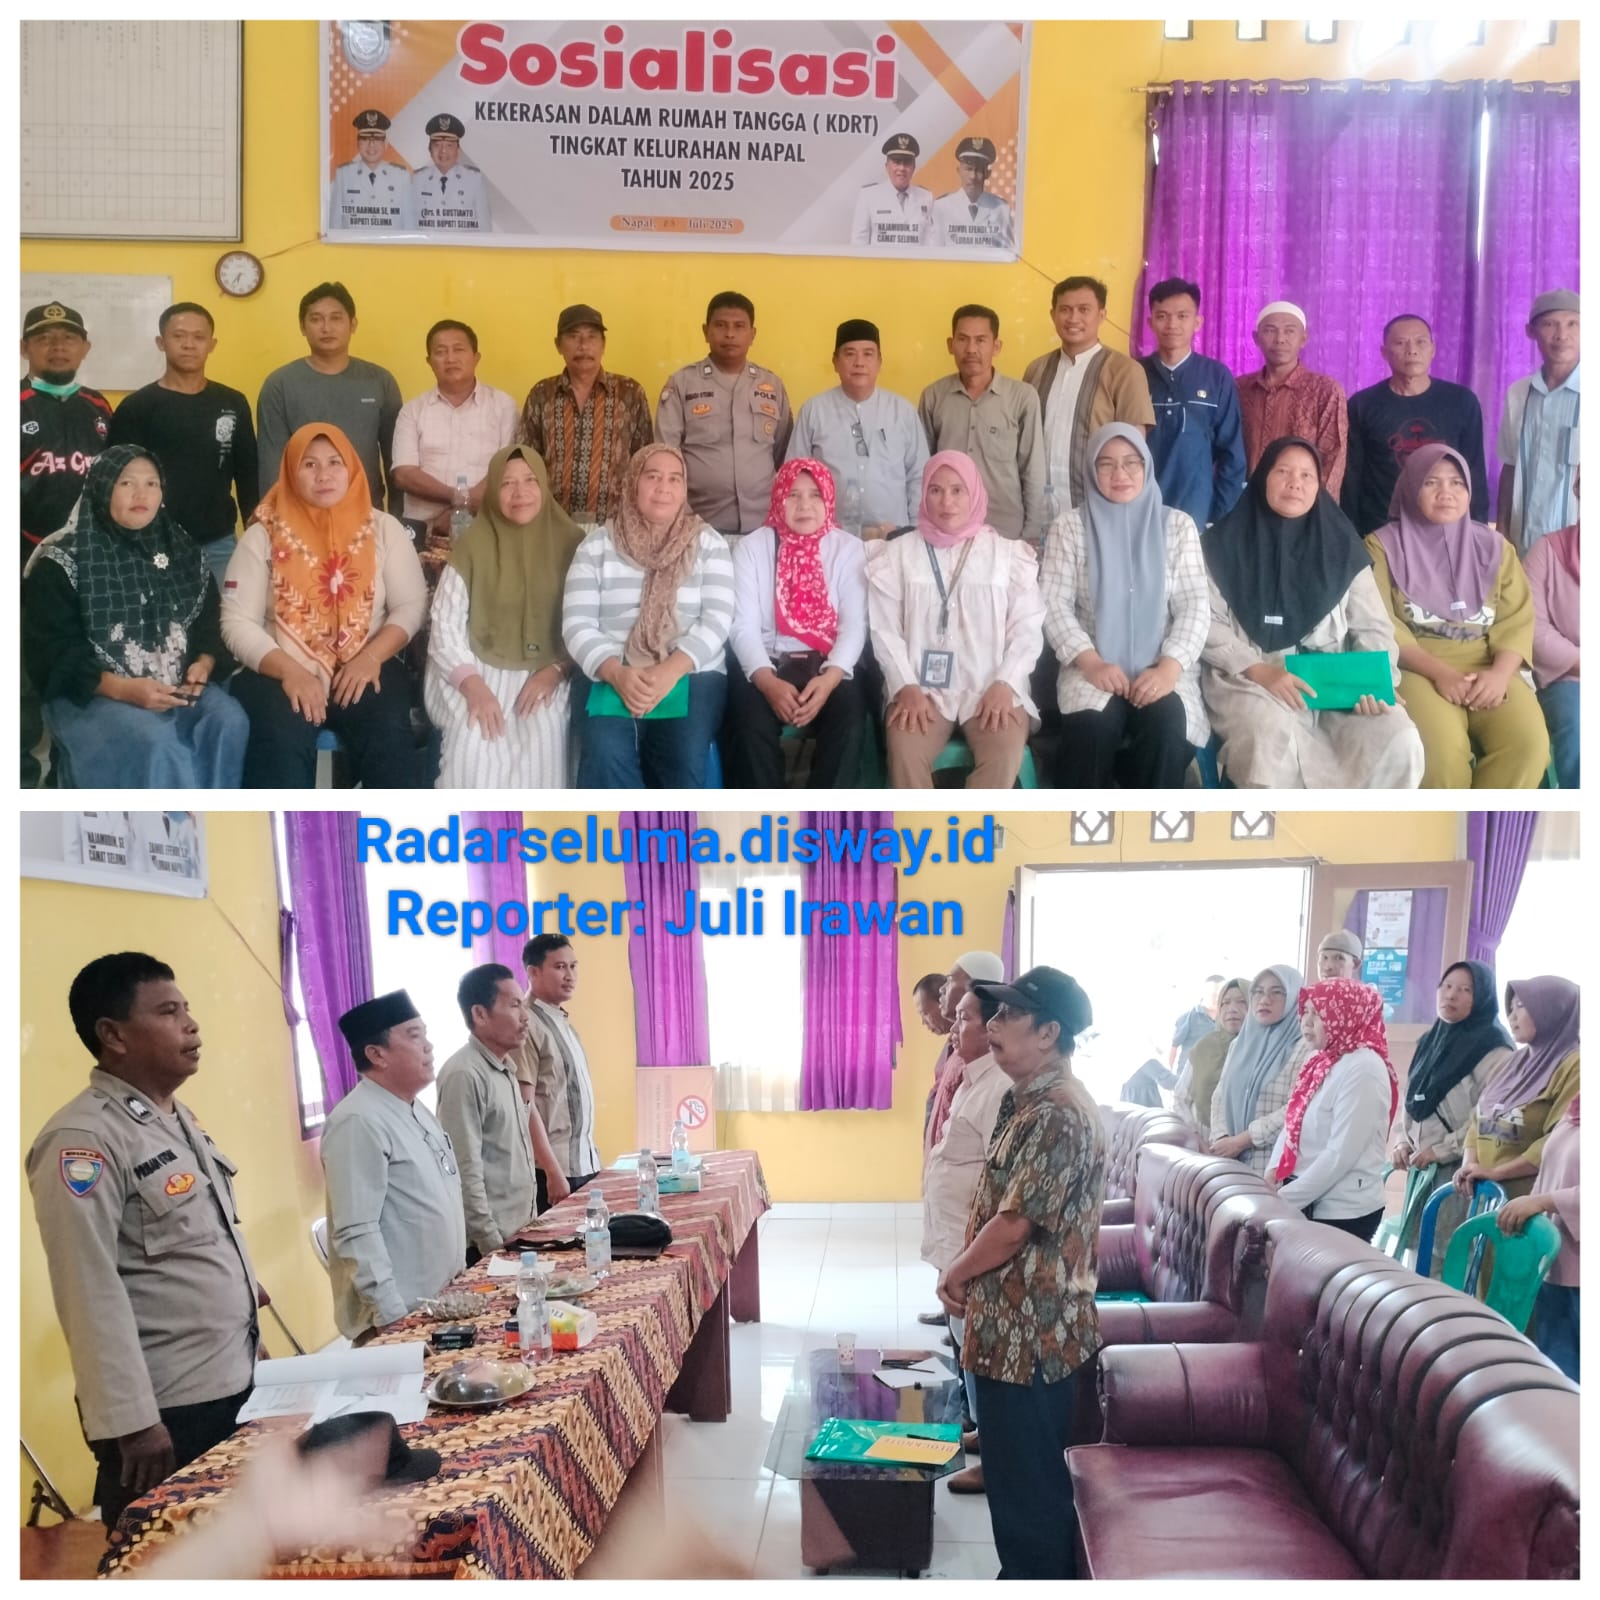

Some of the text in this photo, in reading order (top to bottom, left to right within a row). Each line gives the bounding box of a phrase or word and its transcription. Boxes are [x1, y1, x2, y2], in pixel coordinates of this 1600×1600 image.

[459, 22, 896, 99] Sosialisasi
[474, 101, 582, 125] KEKERASAN
[588, 106, 652, 128] DALAM
[658, 108, 727, 131] RUMAH
[733, 111, 807, 132] TANGGA
[549, 134, 806, 163] TINGKAT KELURAHAN NAPAL
[621, 168, 735, 192] TAHUN 2025
[371, 217, 393, 226] SELUMA
[437, 219, 457, 228] BUPATI
[457, 220, 479, 229] SELUMA
[30, 451, 66, 476] Az
